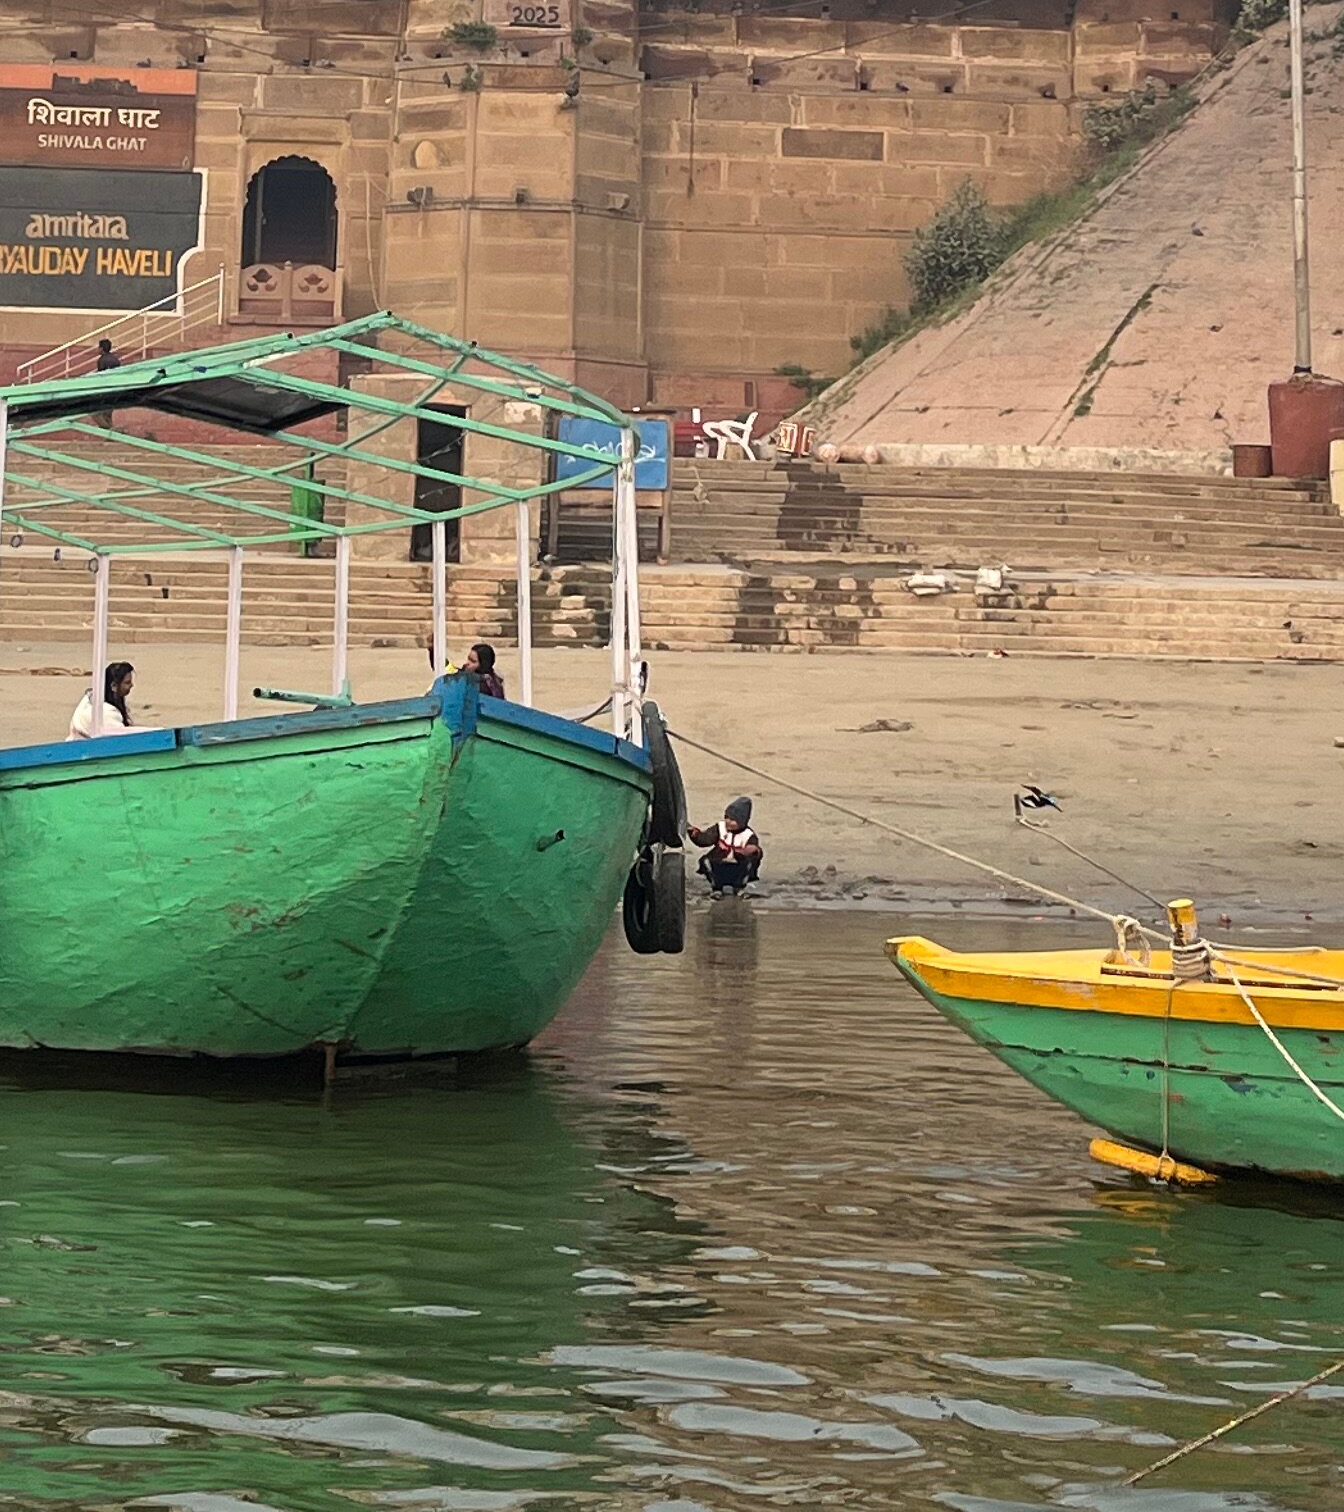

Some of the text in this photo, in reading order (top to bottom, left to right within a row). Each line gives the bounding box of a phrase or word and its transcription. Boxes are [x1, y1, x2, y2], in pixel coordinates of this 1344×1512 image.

[512, 6, 560, 23] 2025
[27, 98, 161, 129] शिवाला घाट
[38, 134, 147, 150] SHIVALA GHAT
[25, 211, 130, 240] amritara
[96, 246, 173, 277] HAVELI
